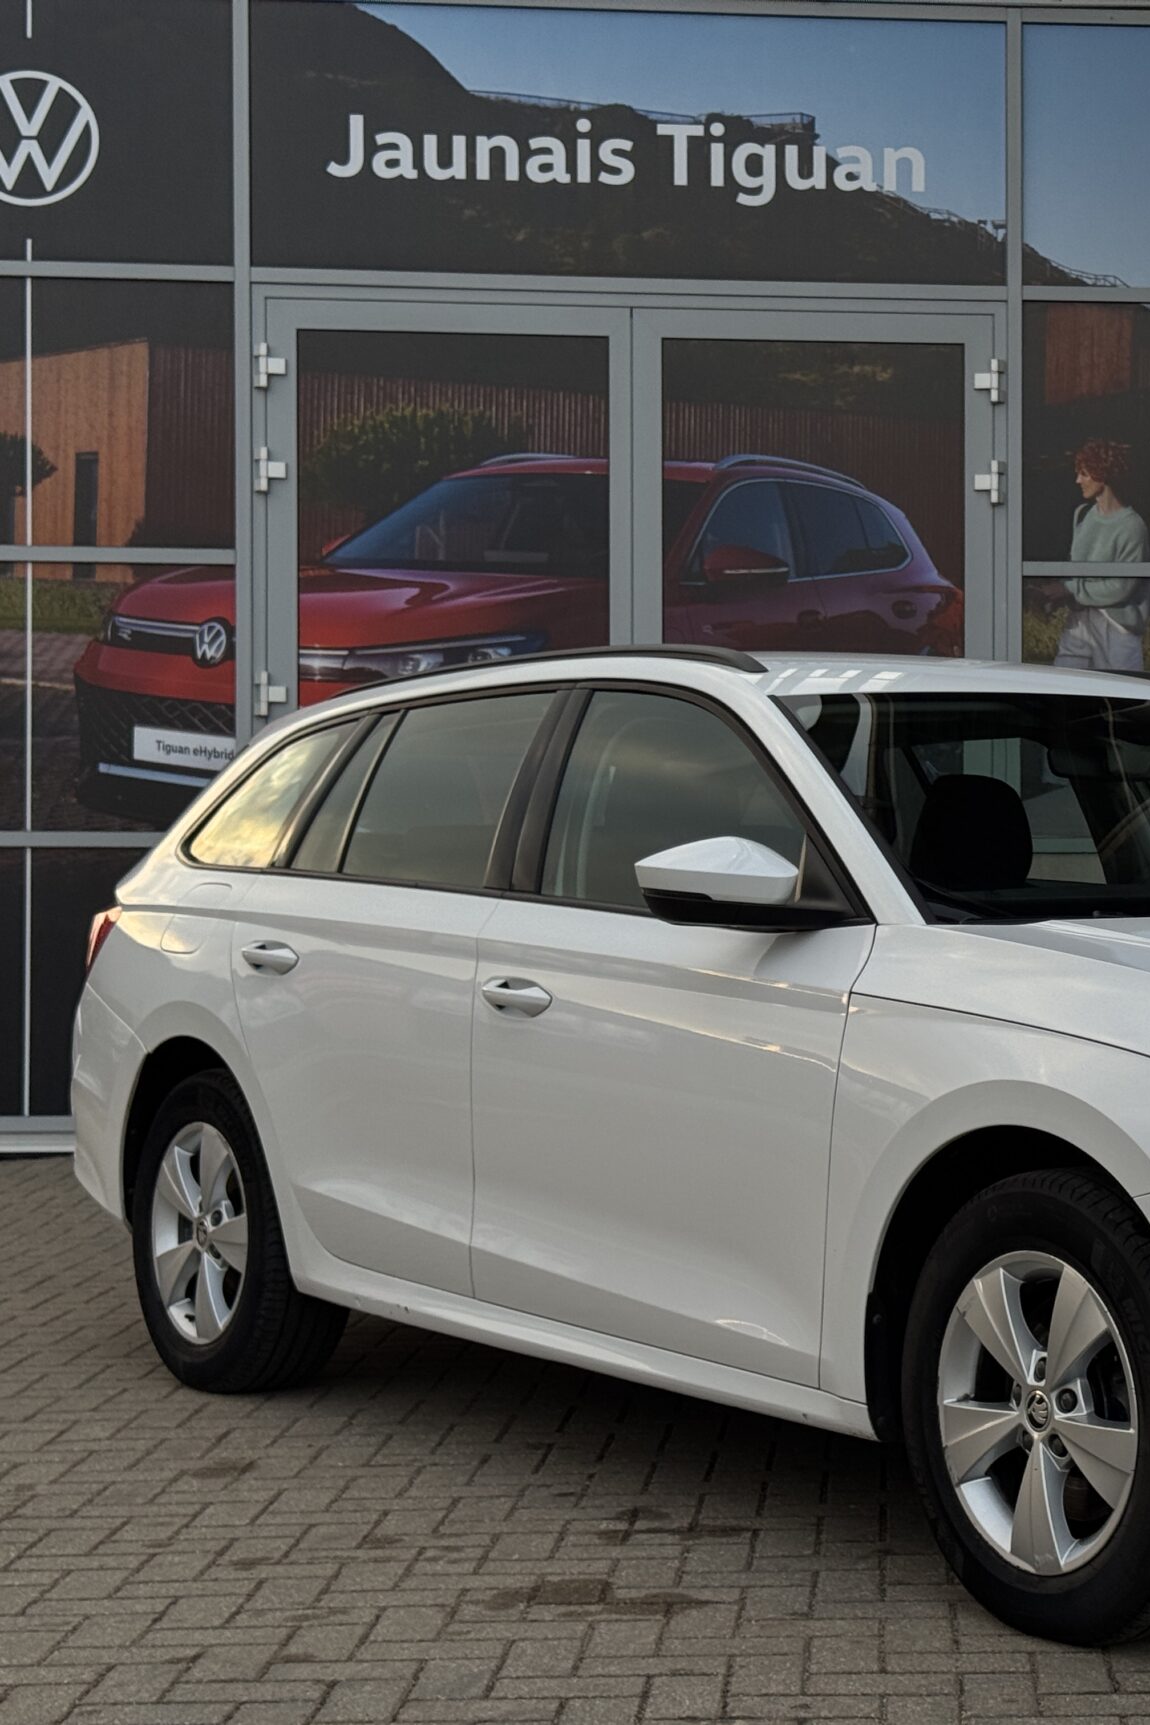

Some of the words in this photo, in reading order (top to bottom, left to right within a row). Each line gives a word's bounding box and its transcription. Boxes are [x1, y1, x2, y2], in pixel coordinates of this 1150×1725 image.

[326, 114, 636, 186] Jaunais
[656, 122, 926, 207] Tiguan
[155, 739, 191, 756] Tiguan
[193, 745, 235, 761] eHybrid
